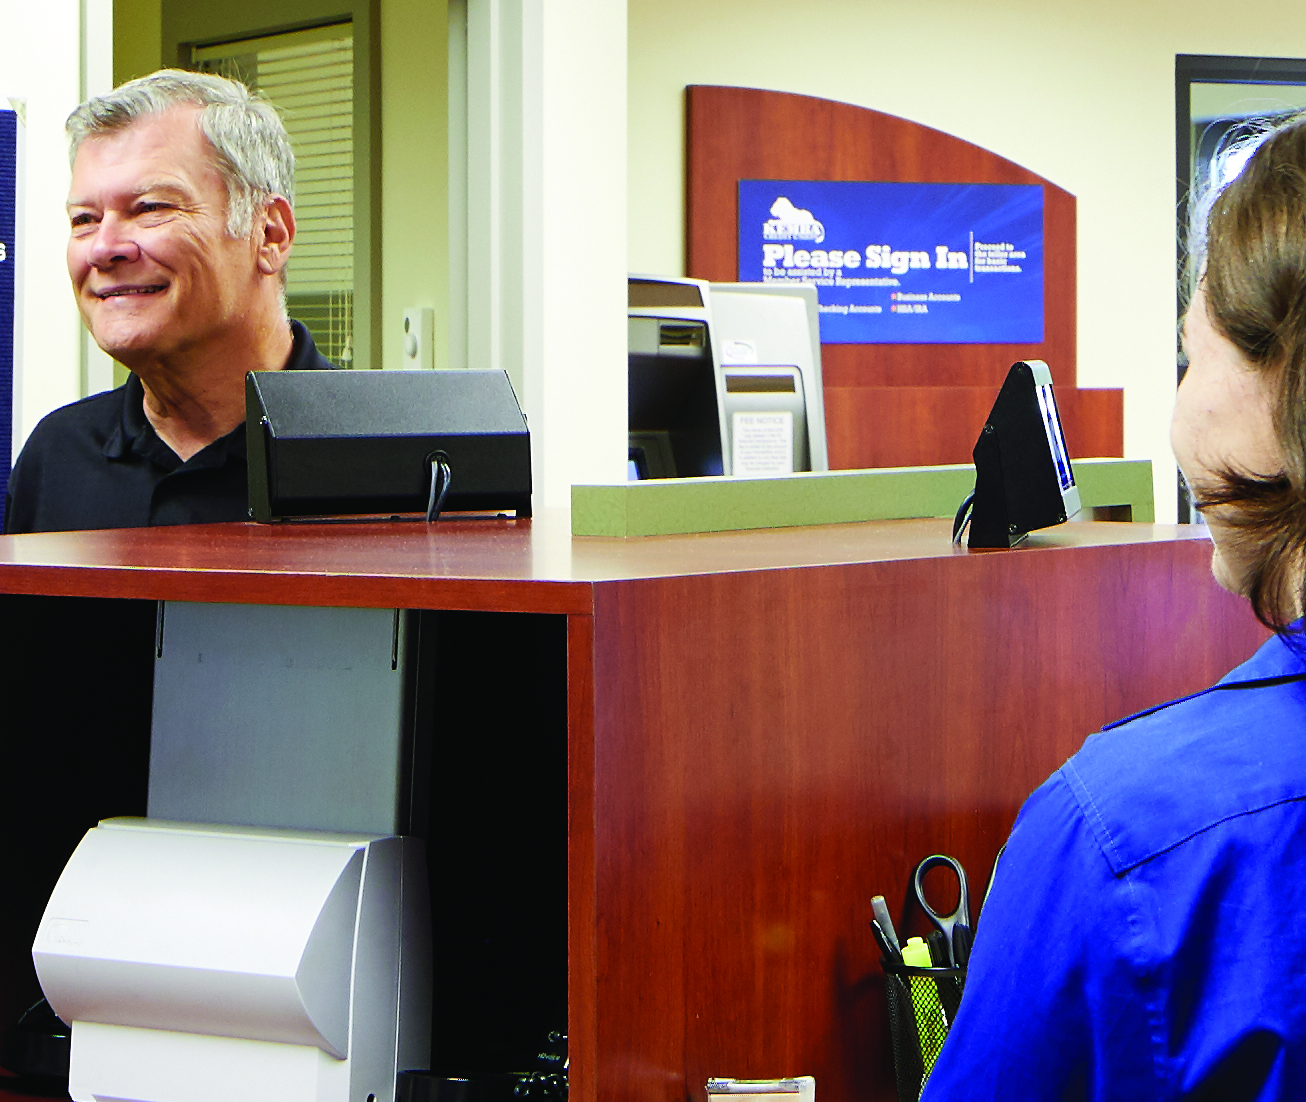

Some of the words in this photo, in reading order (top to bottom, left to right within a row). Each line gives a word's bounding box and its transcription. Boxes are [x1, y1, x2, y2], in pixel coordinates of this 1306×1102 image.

[762, 243, 862, 268] Please
[865, 244, 931, 275] Sign
[935, 245, 969, 269] In
[819, 303, 849, 315] hecking
